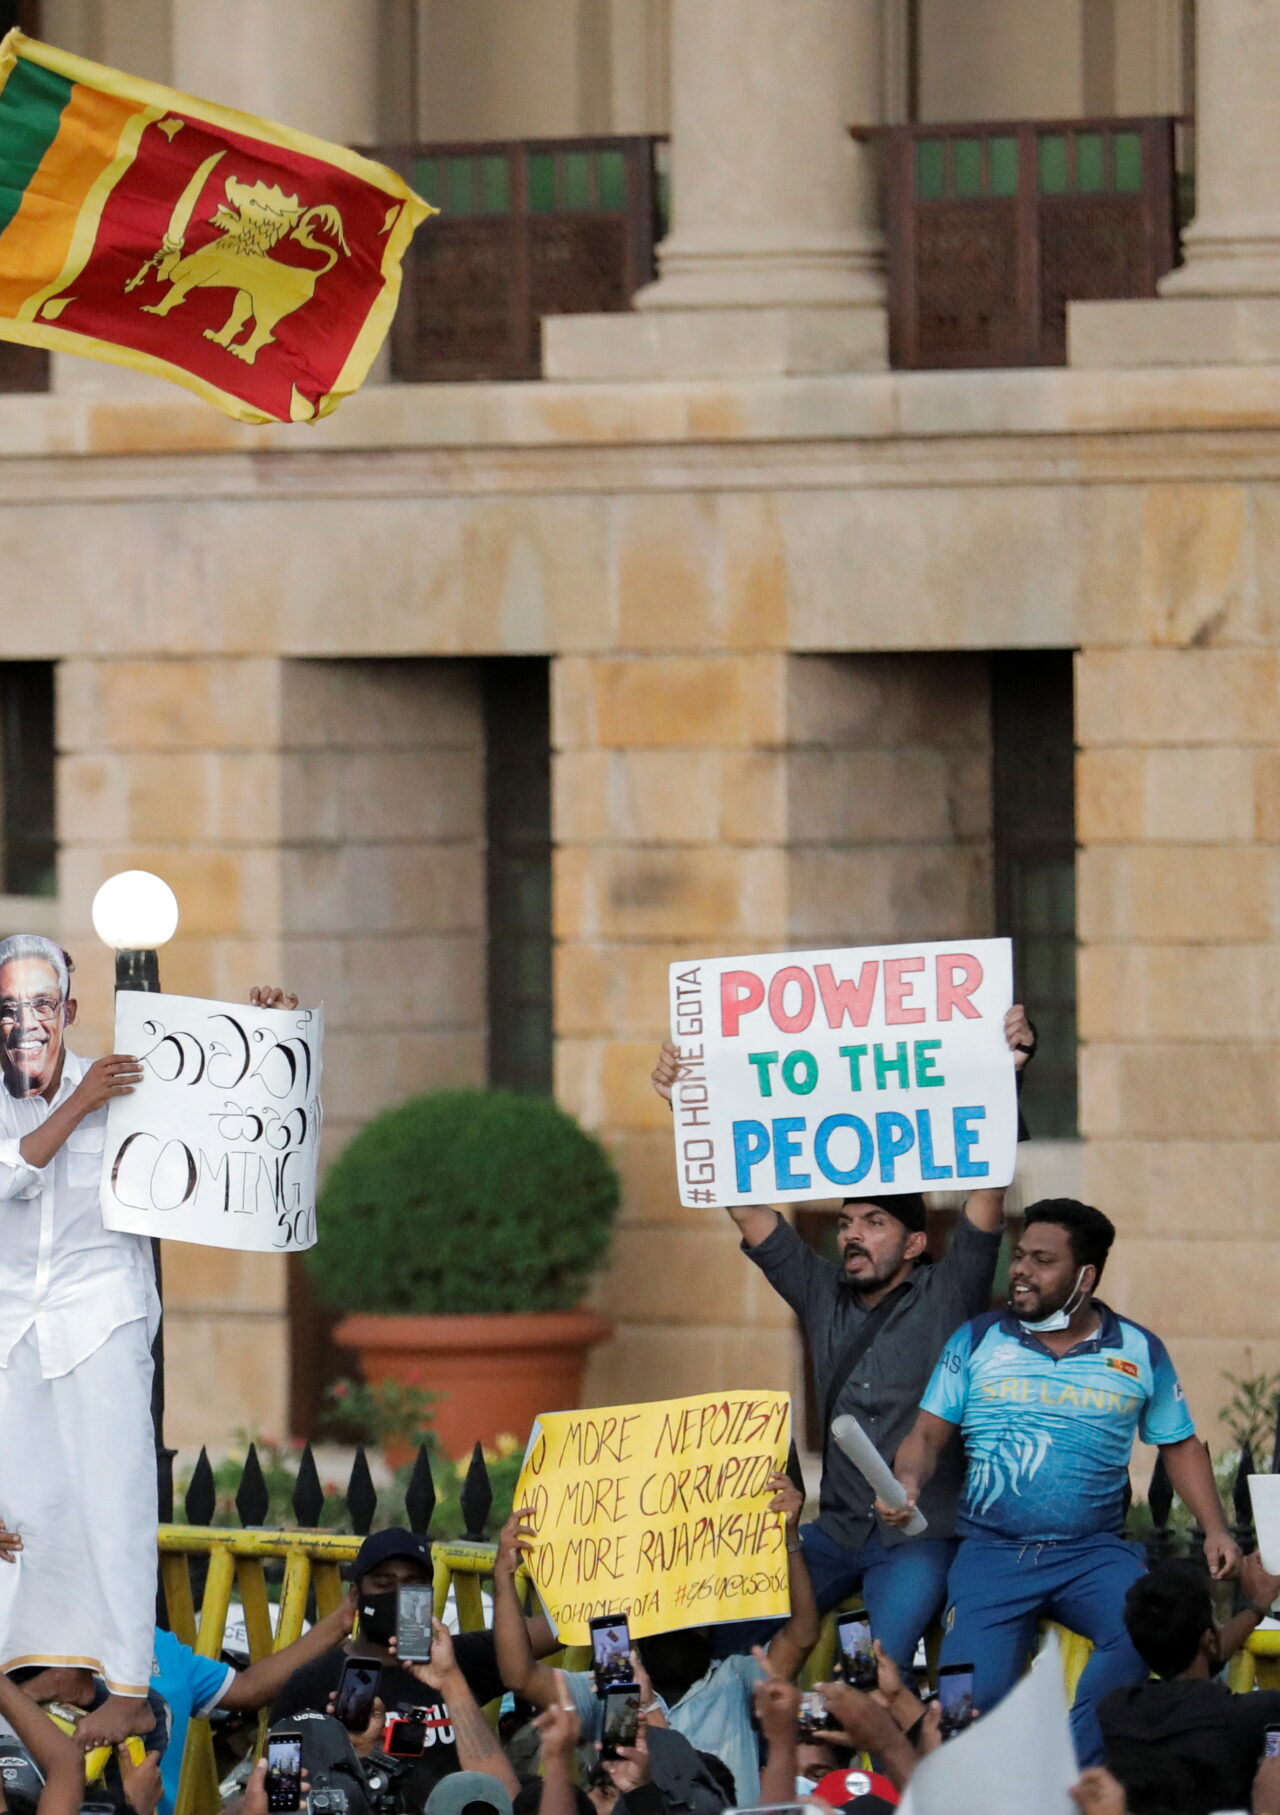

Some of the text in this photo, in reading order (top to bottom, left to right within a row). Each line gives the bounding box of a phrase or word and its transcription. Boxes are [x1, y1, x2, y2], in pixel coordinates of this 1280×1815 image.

[721, 953, 984, 1037] POWER
[676, 967, 717, 1204] #GO HOME GOTA
[748, 1038, 946, 1098] TO THE
[111, 1131, 301, 1215] COMING
[732, 1105, 990, 1193] PEOPLE
[982, 1376, 1033, 1402] SRI
[1041, 1383, 1138, 1414] LANKA
[558, 1415, 641, 1468] MORE
[654, 1400, 790, 1458] NEPOTISM
[520, 1484, 549, 1533] NO
[556, 1476, 631, 1528] MORE
[527, 1511, 784, 1588] NO MORE RAJAPAKSHES
